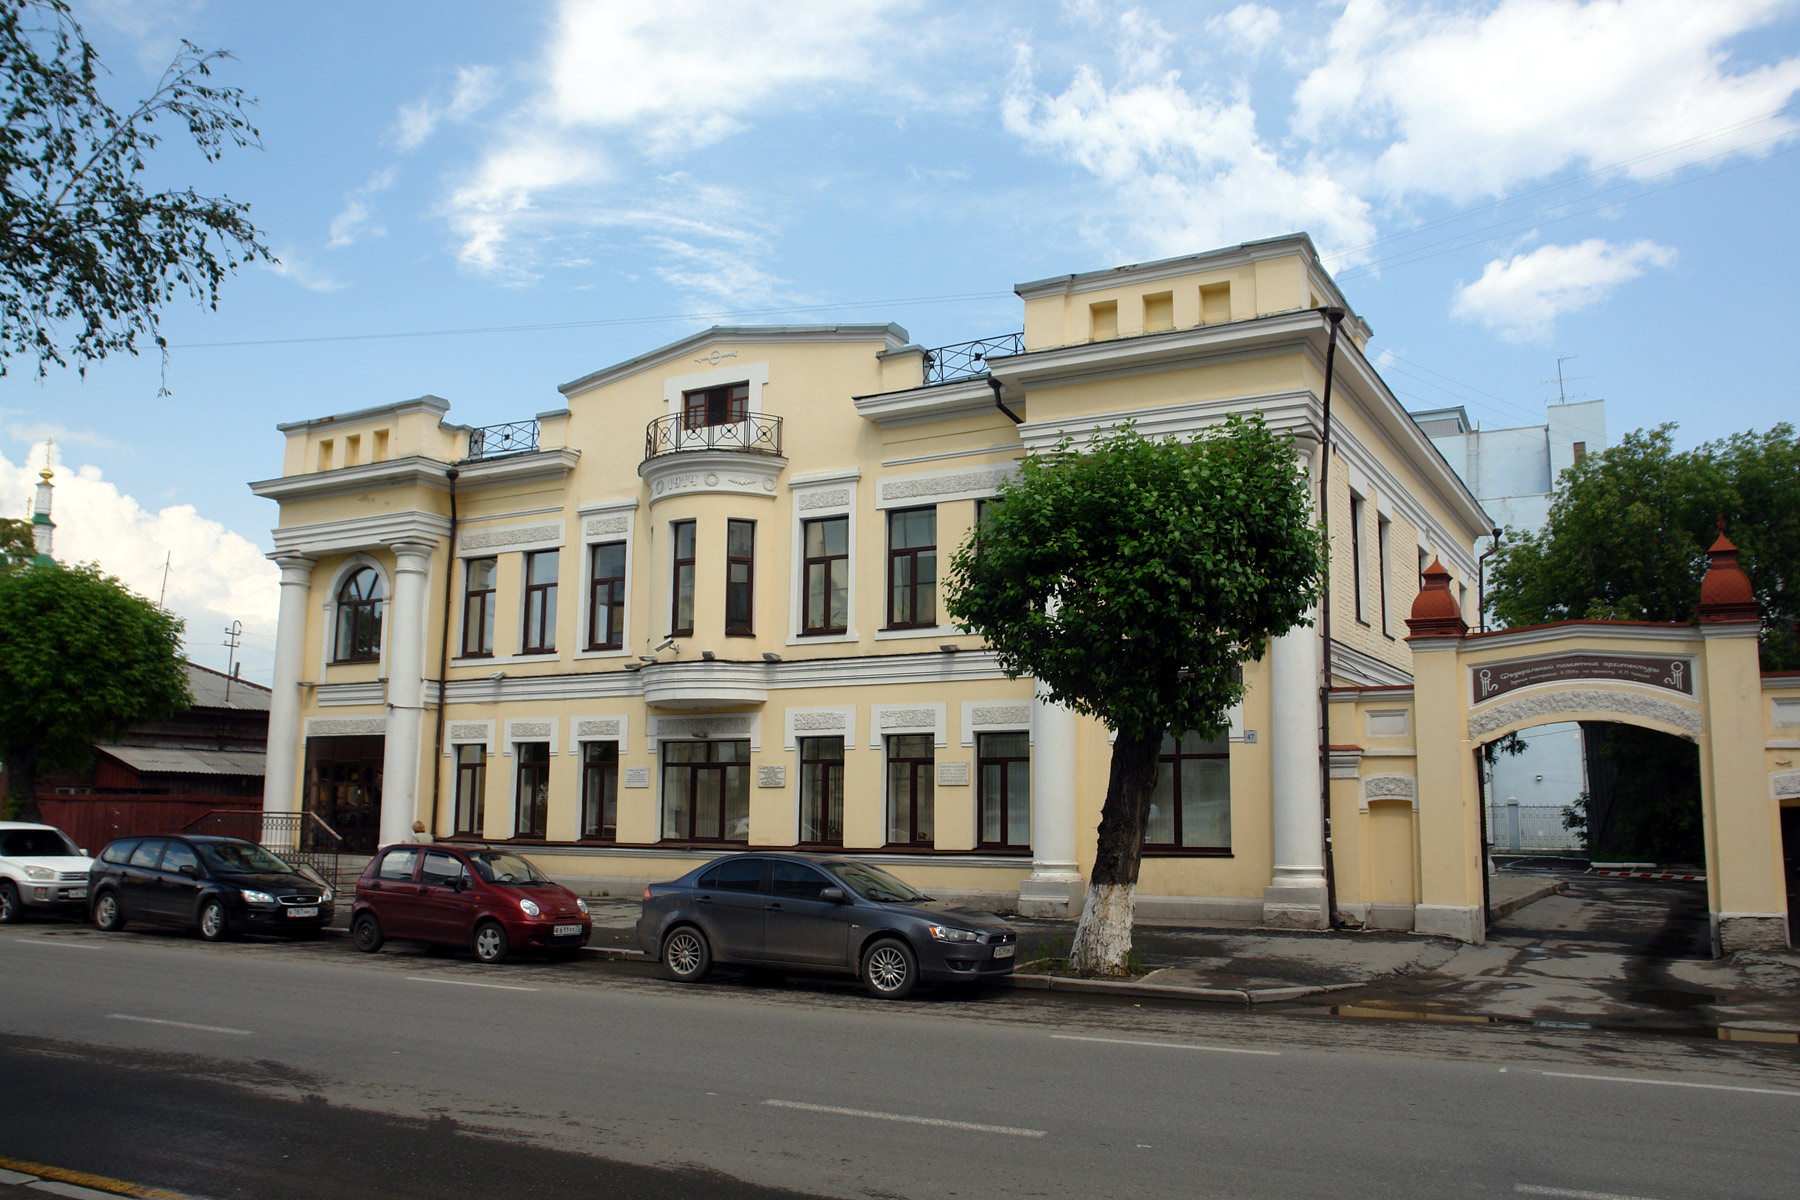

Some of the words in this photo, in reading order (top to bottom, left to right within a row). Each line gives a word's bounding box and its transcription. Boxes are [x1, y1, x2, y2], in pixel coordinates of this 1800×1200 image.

[668, 475, 697, 490] 1914
[1500, 664, 1554, 679] Федеральный
[1603, 661, 1660, 674] архитектуры
